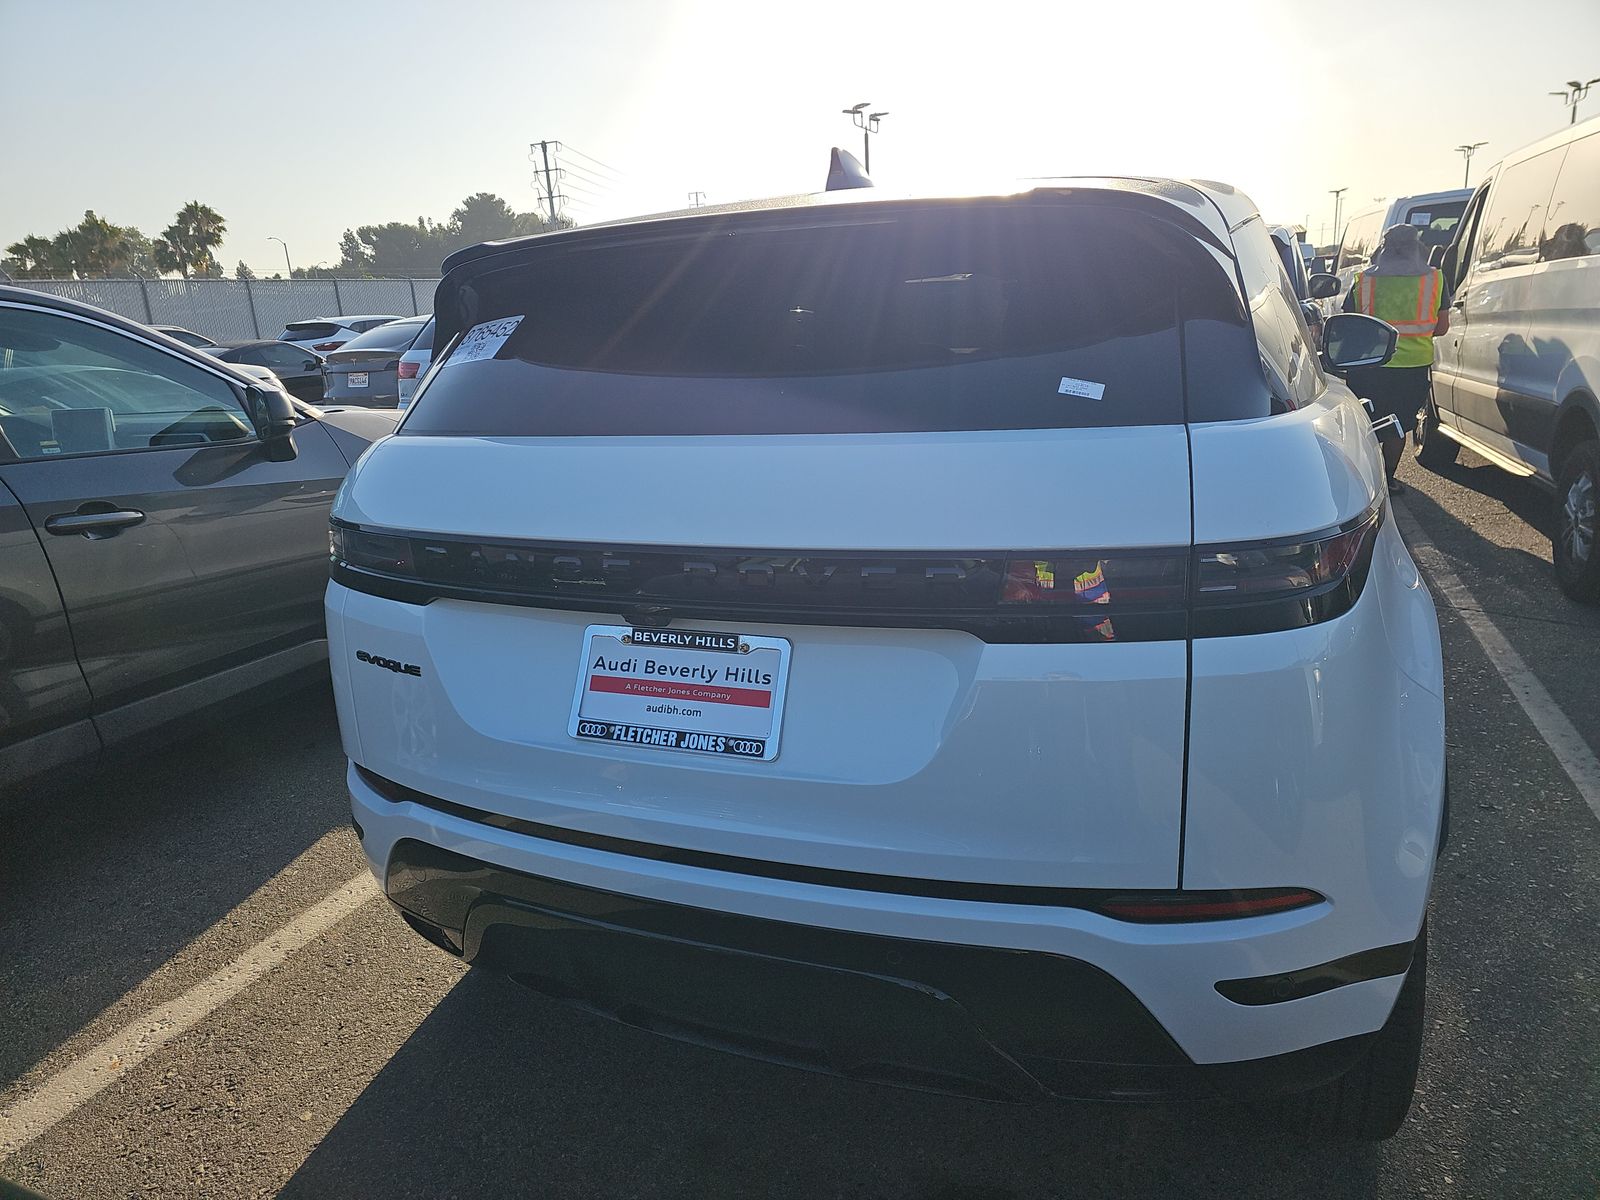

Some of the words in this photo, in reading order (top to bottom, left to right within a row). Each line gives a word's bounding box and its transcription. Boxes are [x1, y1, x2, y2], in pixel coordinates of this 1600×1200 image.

[634, 631, 692, 646] BEVERLY
[696, 636, 735, 649] HILLS
[593, 656, 637, 673] Audi
[645, 659, 718, 683] Beverly
[725, 666, 772, 685] Hills
[633, 684, 666, 694] Fletcher
[668, 687, 691, 696] Jones
[693, 689, 732, 700] Company
[646, 704, 702, 717] audibh.com
[613, 725, 677, 747] FLETCHER
[680, 734, 726, 752] JONES
